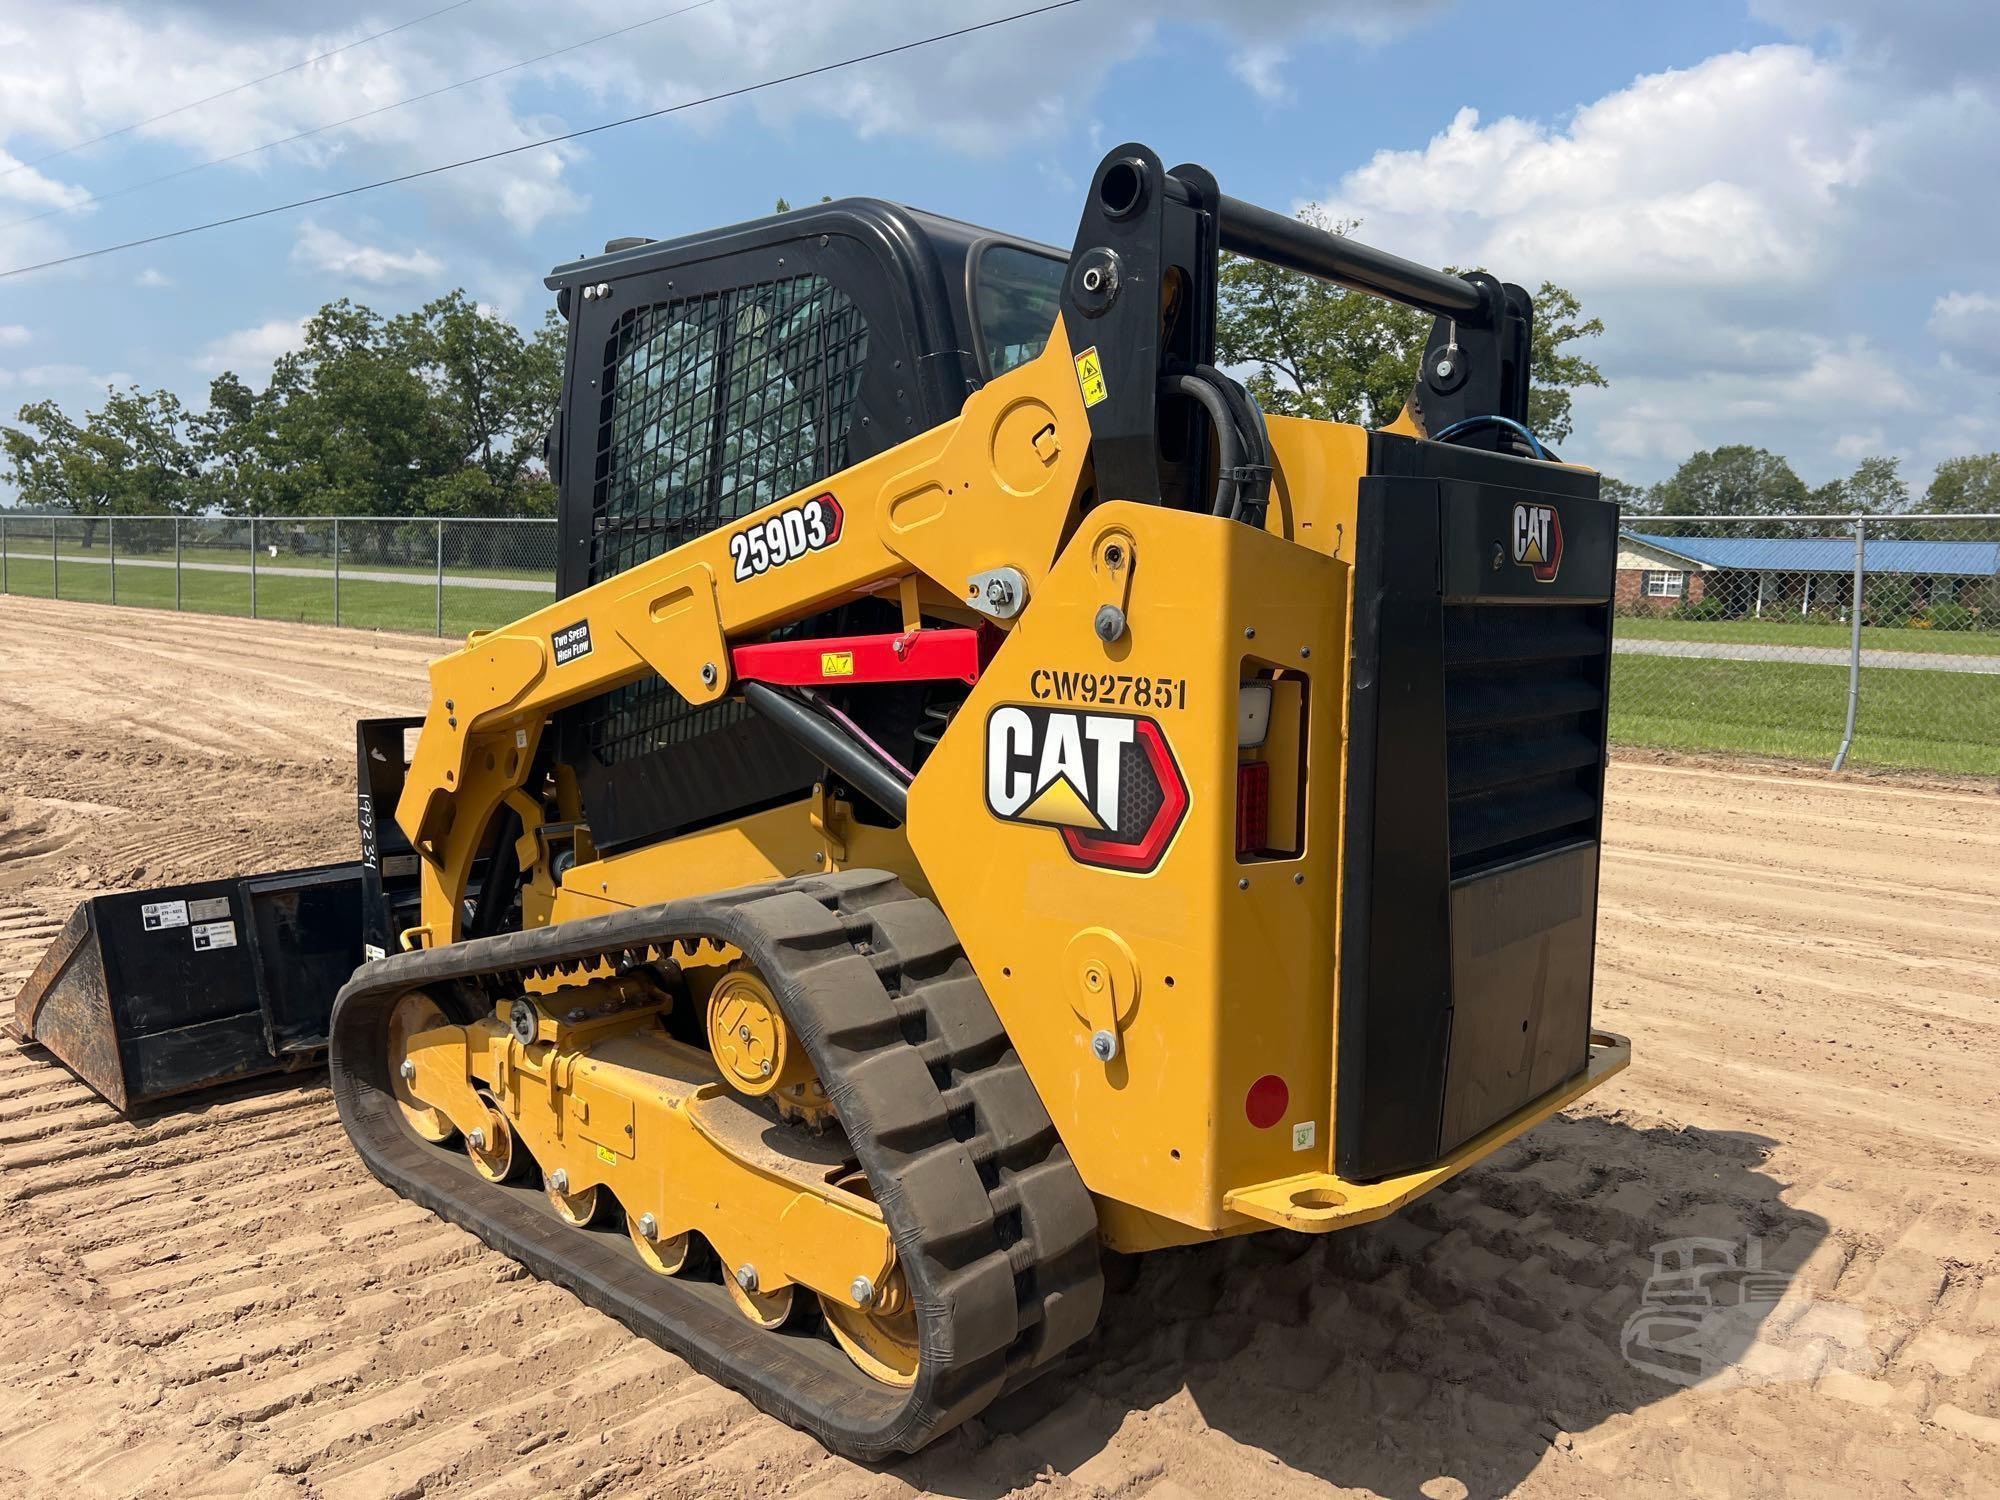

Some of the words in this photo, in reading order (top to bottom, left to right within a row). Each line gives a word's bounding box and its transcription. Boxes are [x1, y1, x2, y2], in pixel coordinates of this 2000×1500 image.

[731, 501, 827, 580] 259D3
[1513, 505, 1551, 562] CAT
[1030, 669, 1186, 710] CW927851
[988, 706, 1135, 832] CAT
[358, 794, 377, 870] 199234
